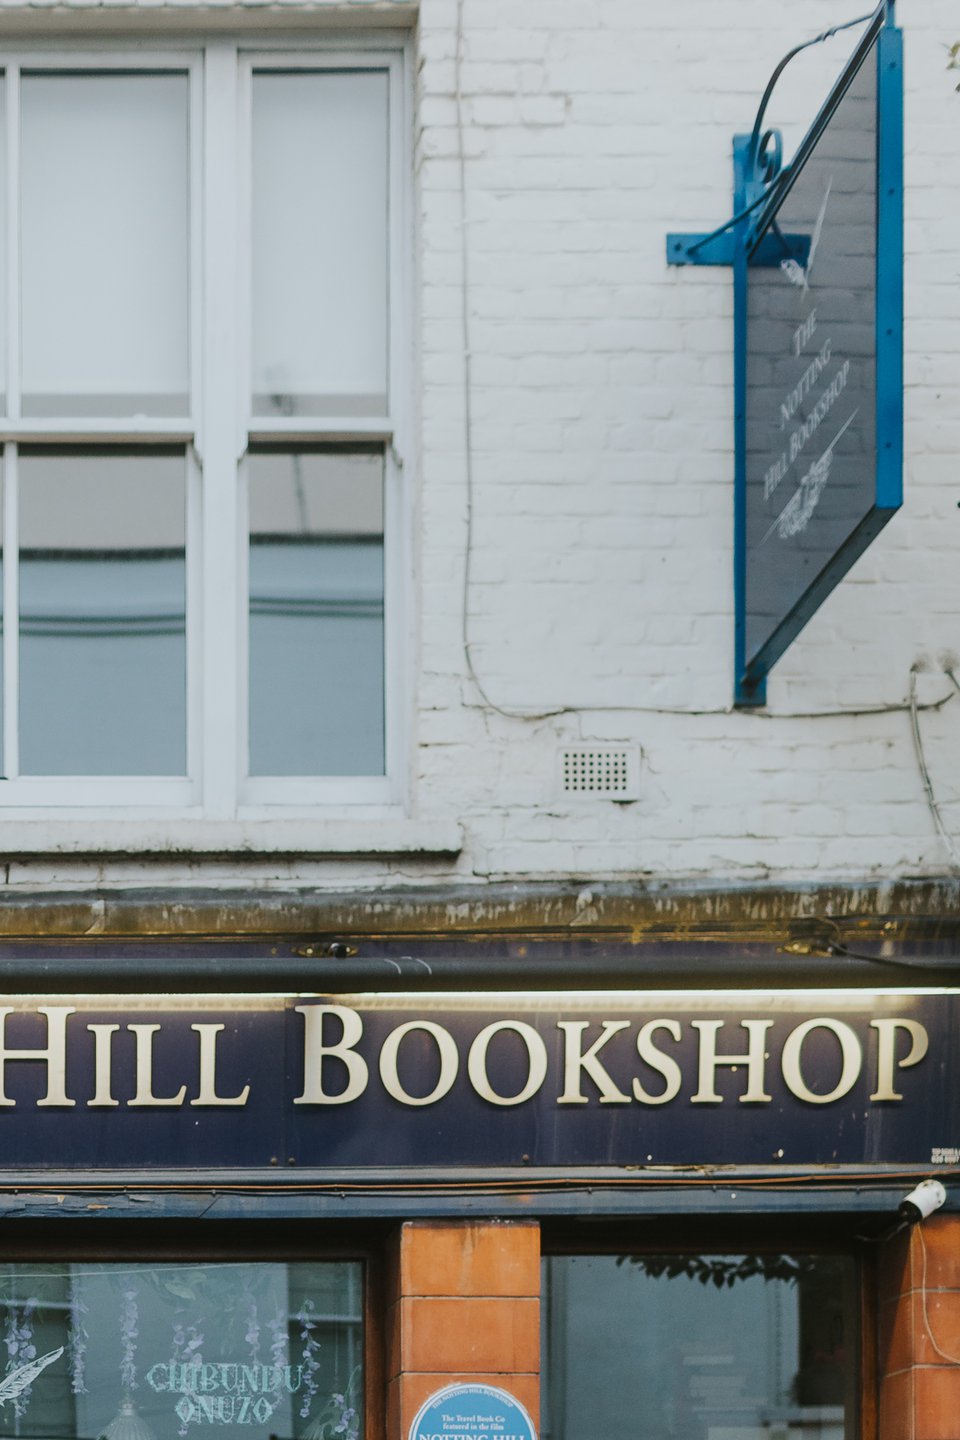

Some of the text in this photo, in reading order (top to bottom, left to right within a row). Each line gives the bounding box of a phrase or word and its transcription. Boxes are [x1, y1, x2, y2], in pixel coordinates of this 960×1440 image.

[793, 308, 817, 359] THE
[780, 338, 832, 431] NOTTING
[763, 360, 850, 502] HILL BOOKSHOP
[294, 1005, 930, 1107] BOOKSHOP
[145, 1362, 304, 1393] CHIBUNDU
[175, 1396, 274, 1424] ONUZO
